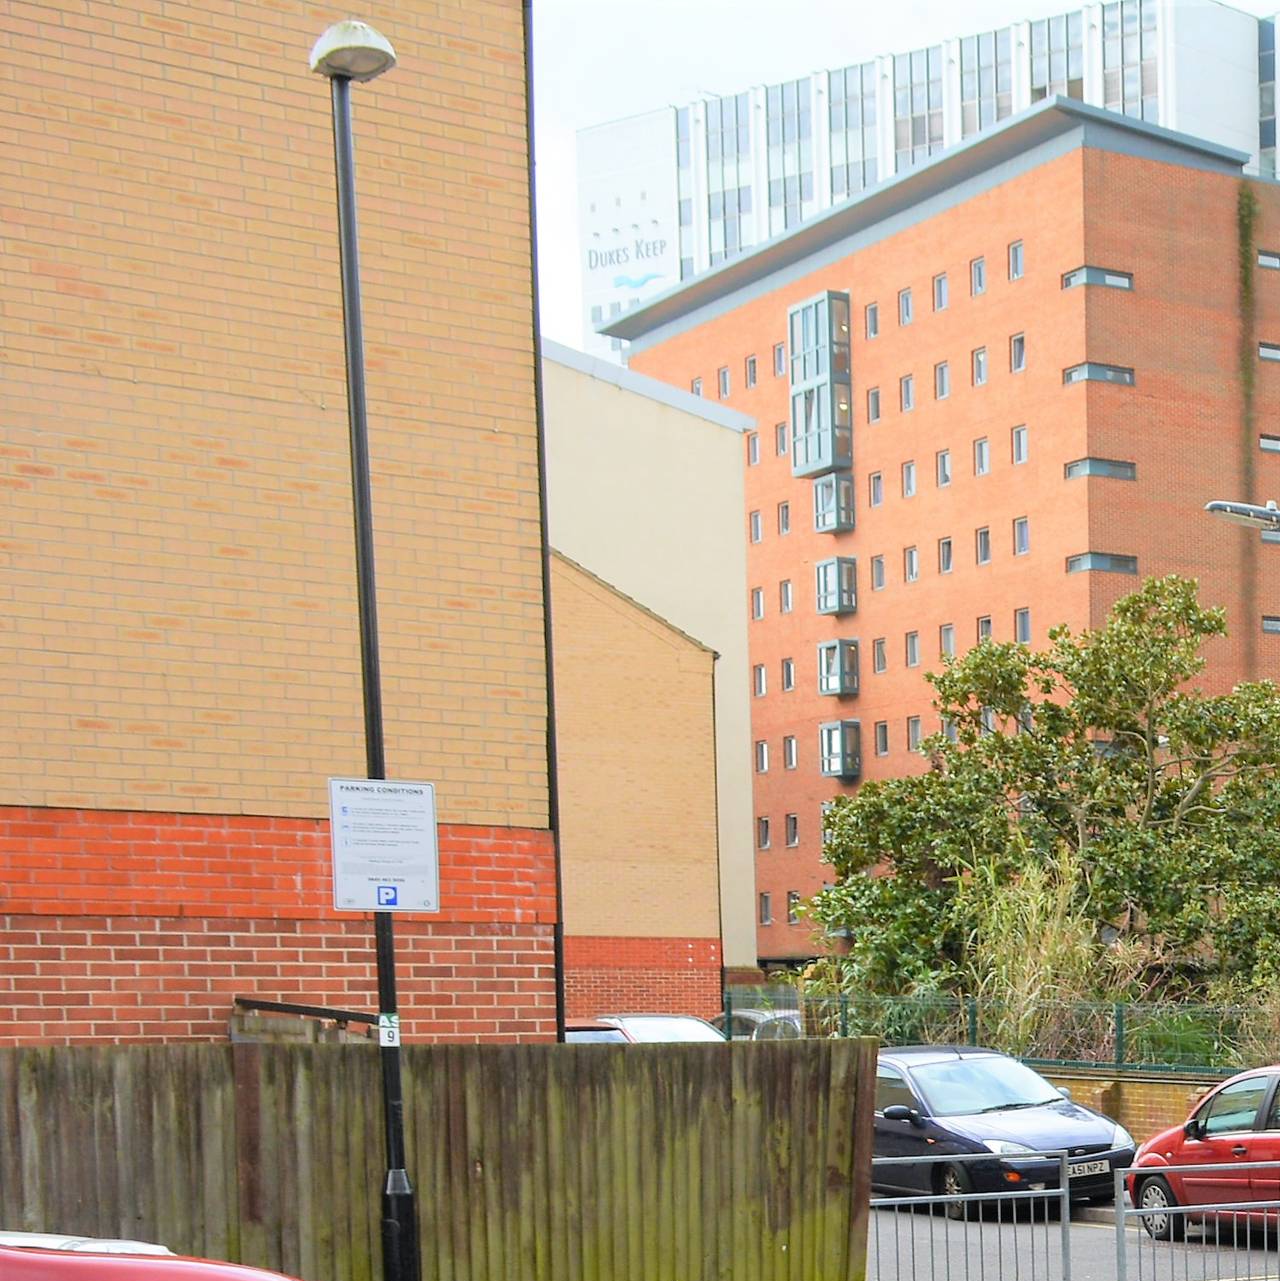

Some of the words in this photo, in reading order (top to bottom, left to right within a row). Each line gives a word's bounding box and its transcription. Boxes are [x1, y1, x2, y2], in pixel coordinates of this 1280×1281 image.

[339, 785, 375, 793] PARKING
[377, 786, 424, 795] CONDITIONS
[387, 1030, 395, 1043] 9
